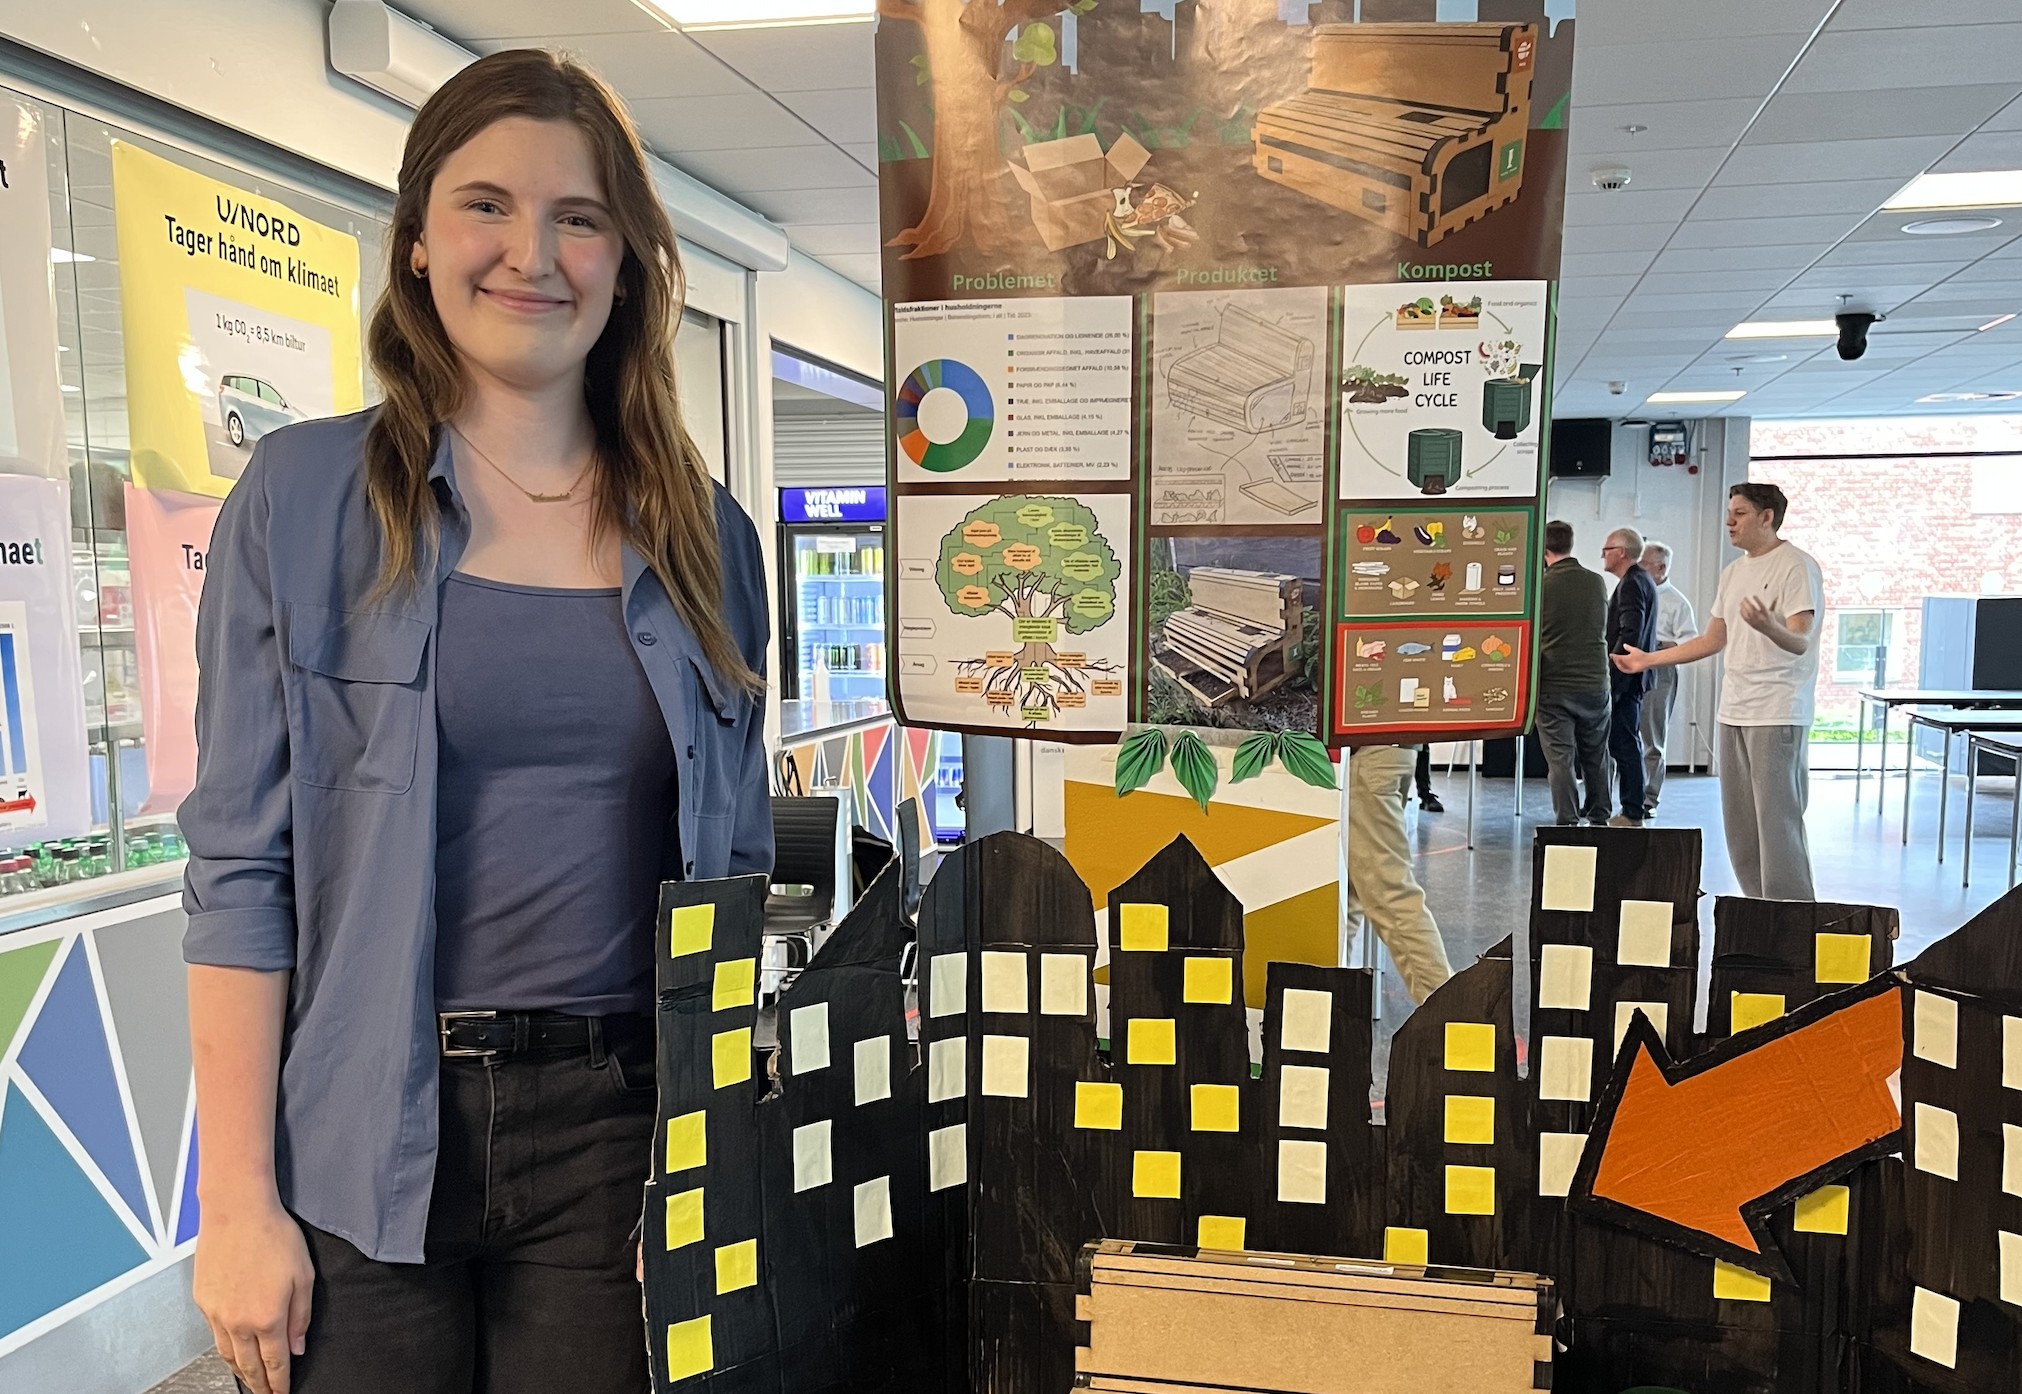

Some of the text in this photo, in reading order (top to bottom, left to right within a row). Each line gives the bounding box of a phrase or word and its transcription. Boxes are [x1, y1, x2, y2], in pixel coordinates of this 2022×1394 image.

[216, 195, 300, 247] U/NORD
[164, 214, 340, 298] Tager hånd om klimaet
[1176, 265, 1278, 285] Produktet
[1397, 260, 1493, 282] Kompost
[953, 272, 1055, 291] Problemet
[216, 313, 222, 329] 1
[222, 314, 233, 336] kg
[256, 325, 270, 344] 8,5
[271, 328, 284, 347] km
[285, 332, 306, 352] biltur
[1404, 350, 1472, 365] COMPOST
[1423, 372, 1451, 386] LIFE
[1415, 393, 1458, 407] CYCLE
[804, 490, 866, 505] VITAMIN
[803, 503, 844, 518] WELL
[181, 543, 207, 571] Ta
